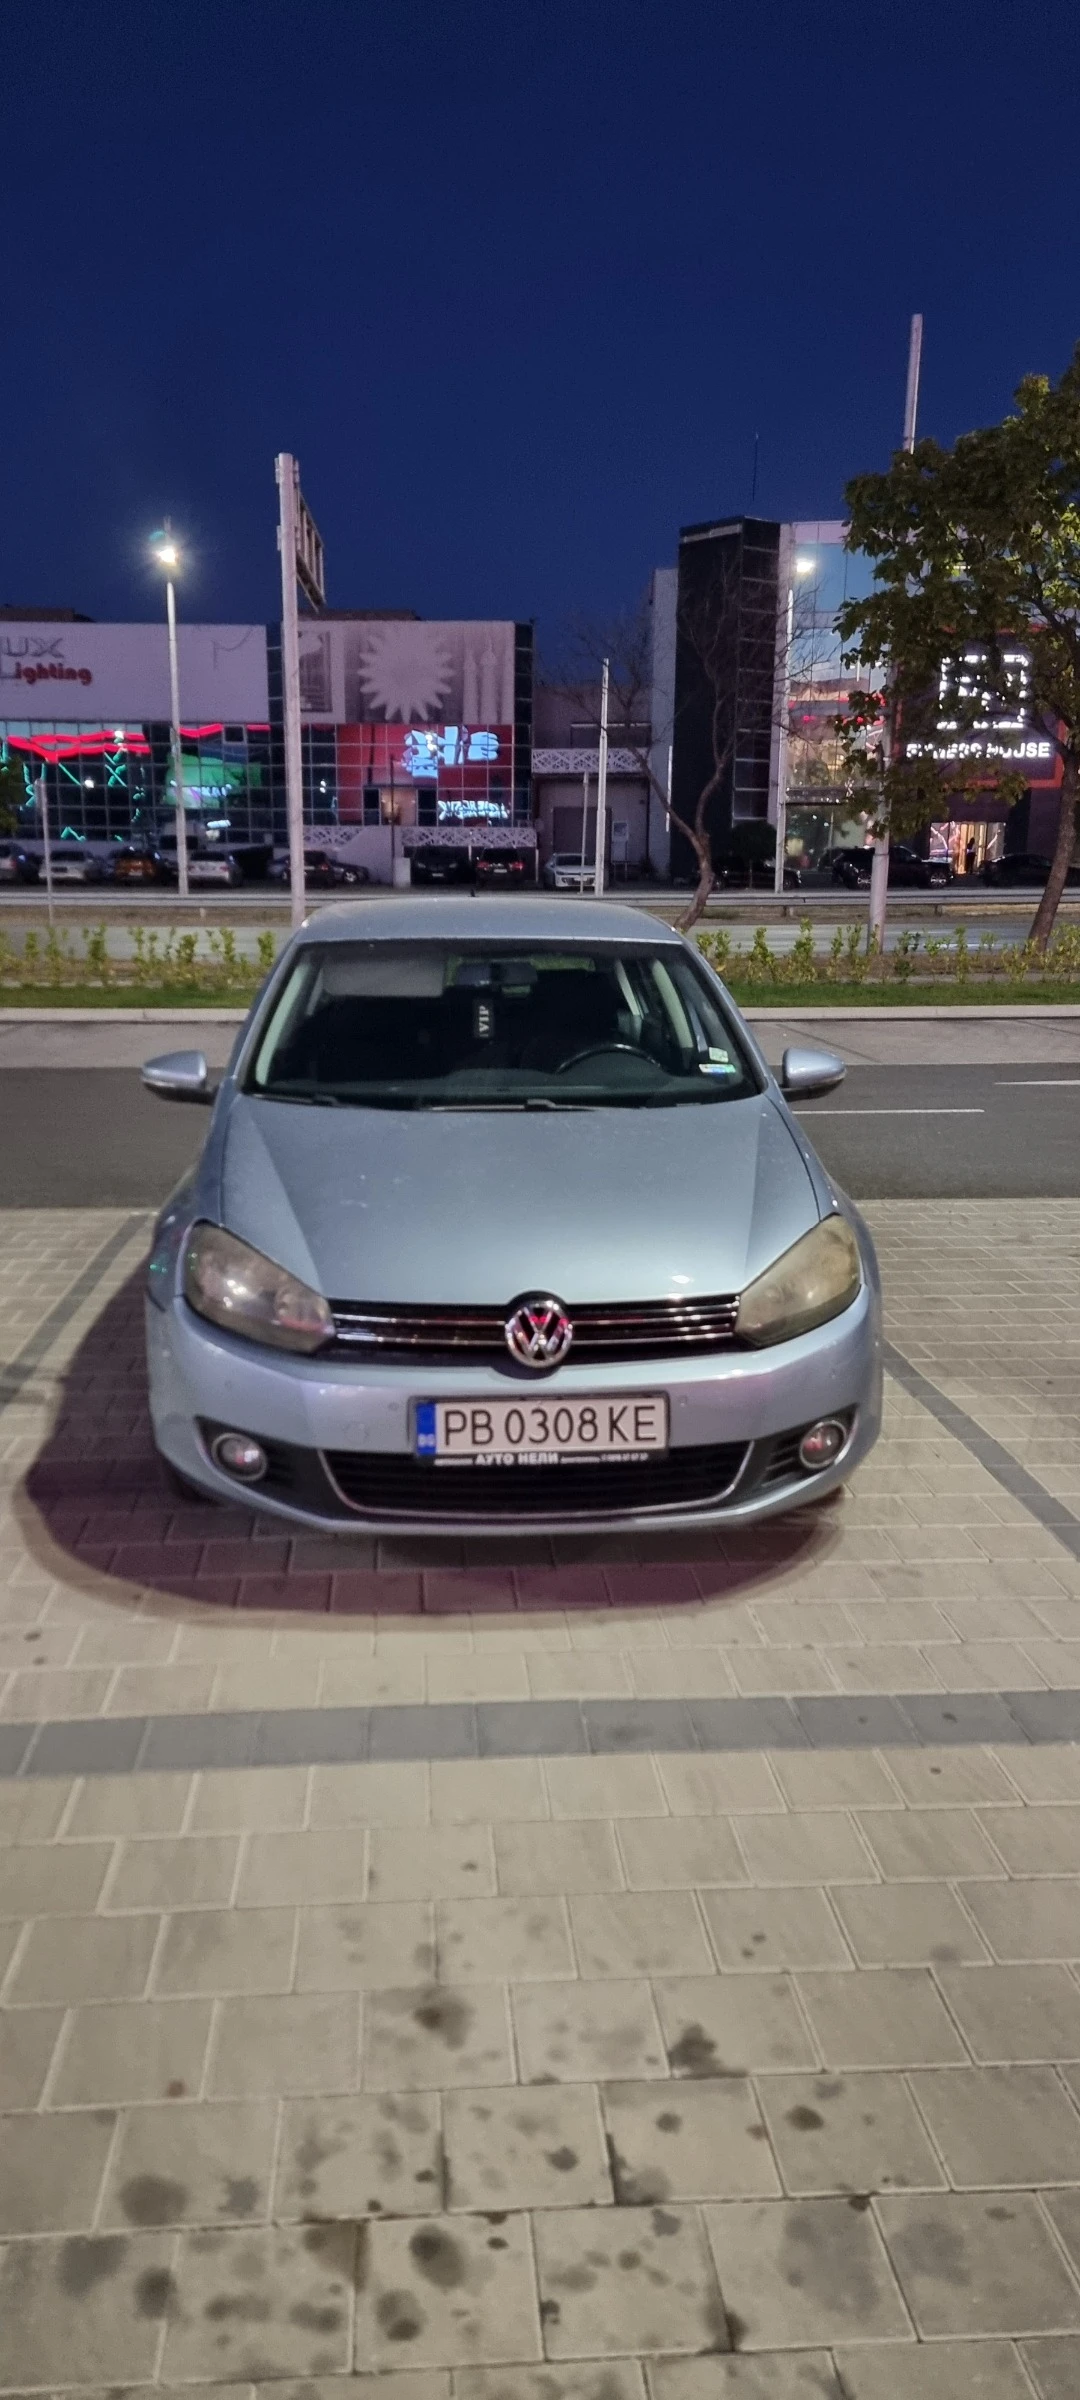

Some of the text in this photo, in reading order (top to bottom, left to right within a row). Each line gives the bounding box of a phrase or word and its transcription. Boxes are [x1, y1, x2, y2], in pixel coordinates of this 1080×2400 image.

[444, 1405, 658, 1447] PB 0308 KE
[517, 1452, 559, 1465] НЕЛИ
